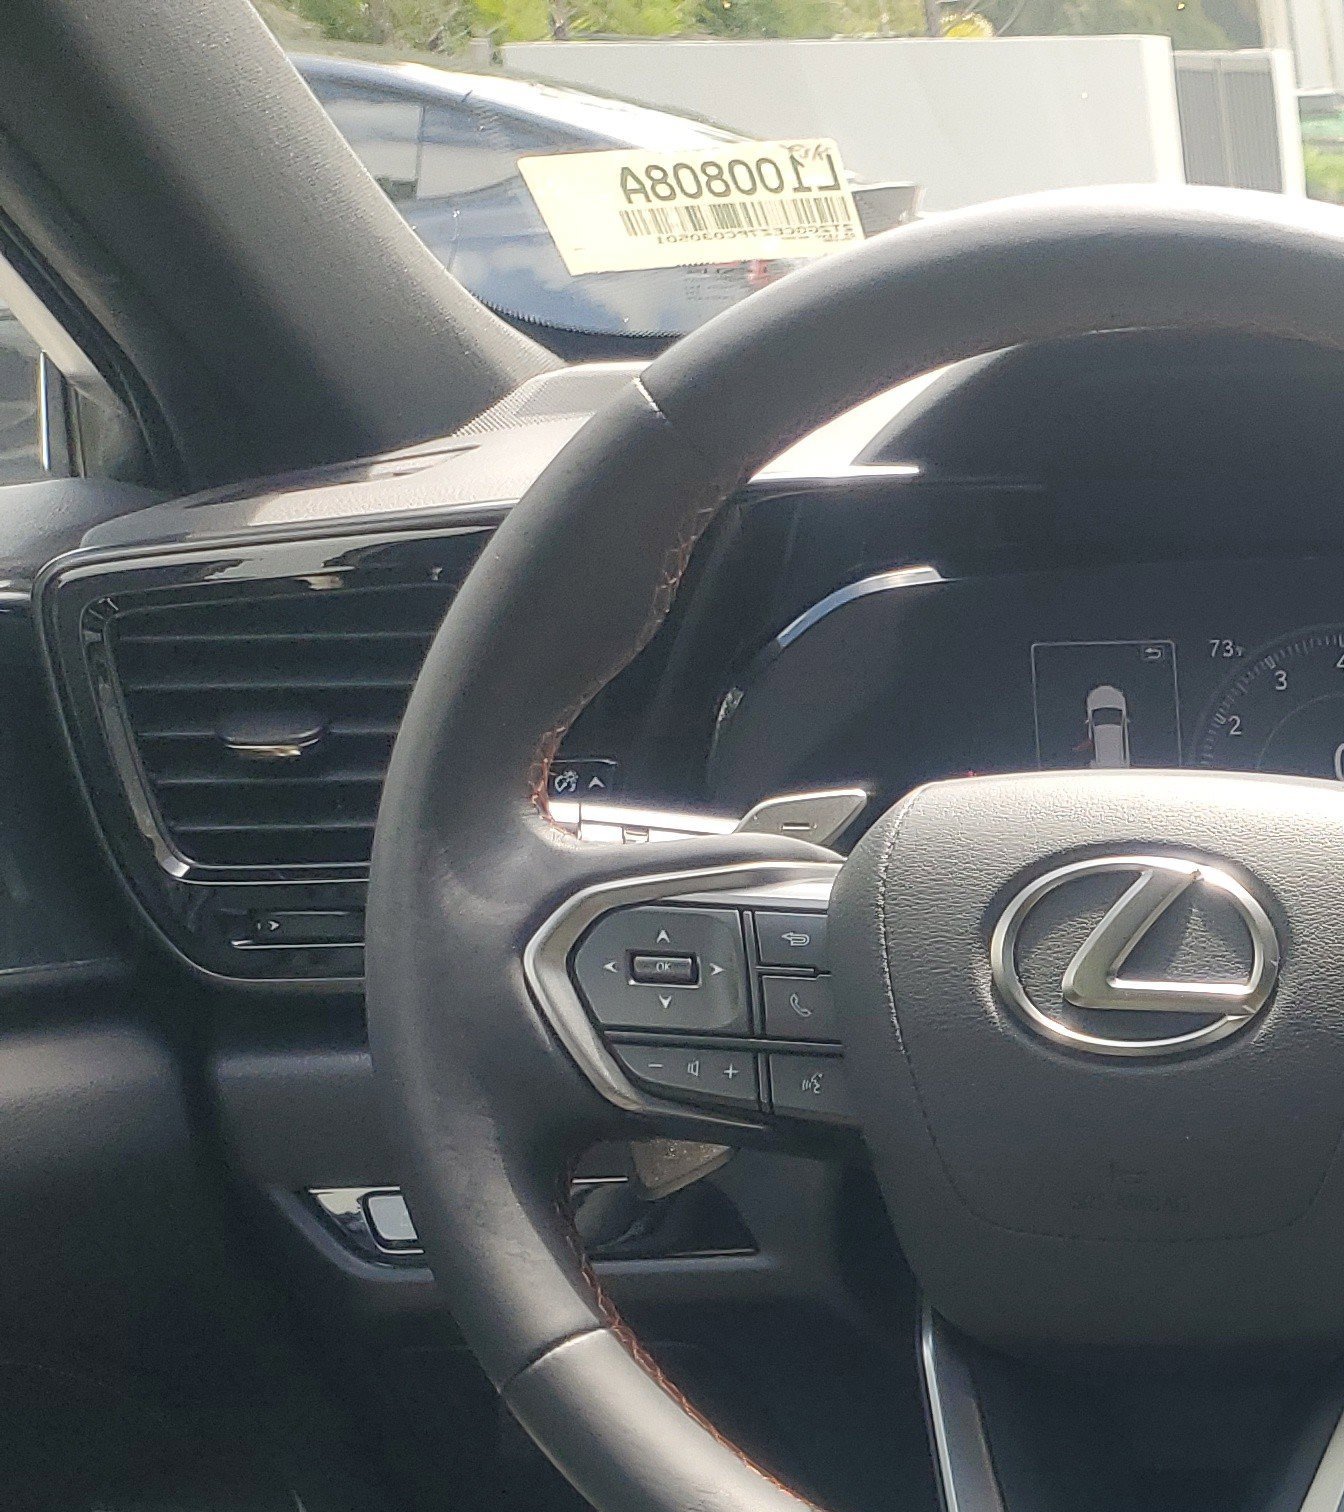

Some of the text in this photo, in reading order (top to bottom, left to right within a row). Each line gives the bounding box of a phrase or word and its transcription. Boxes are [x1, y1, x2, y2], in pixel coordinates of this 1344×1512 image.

[1275, 671, 1288, 691] 3
[1228, 716, 1243, 736] 2
[655, 961, 673, 974] OK
